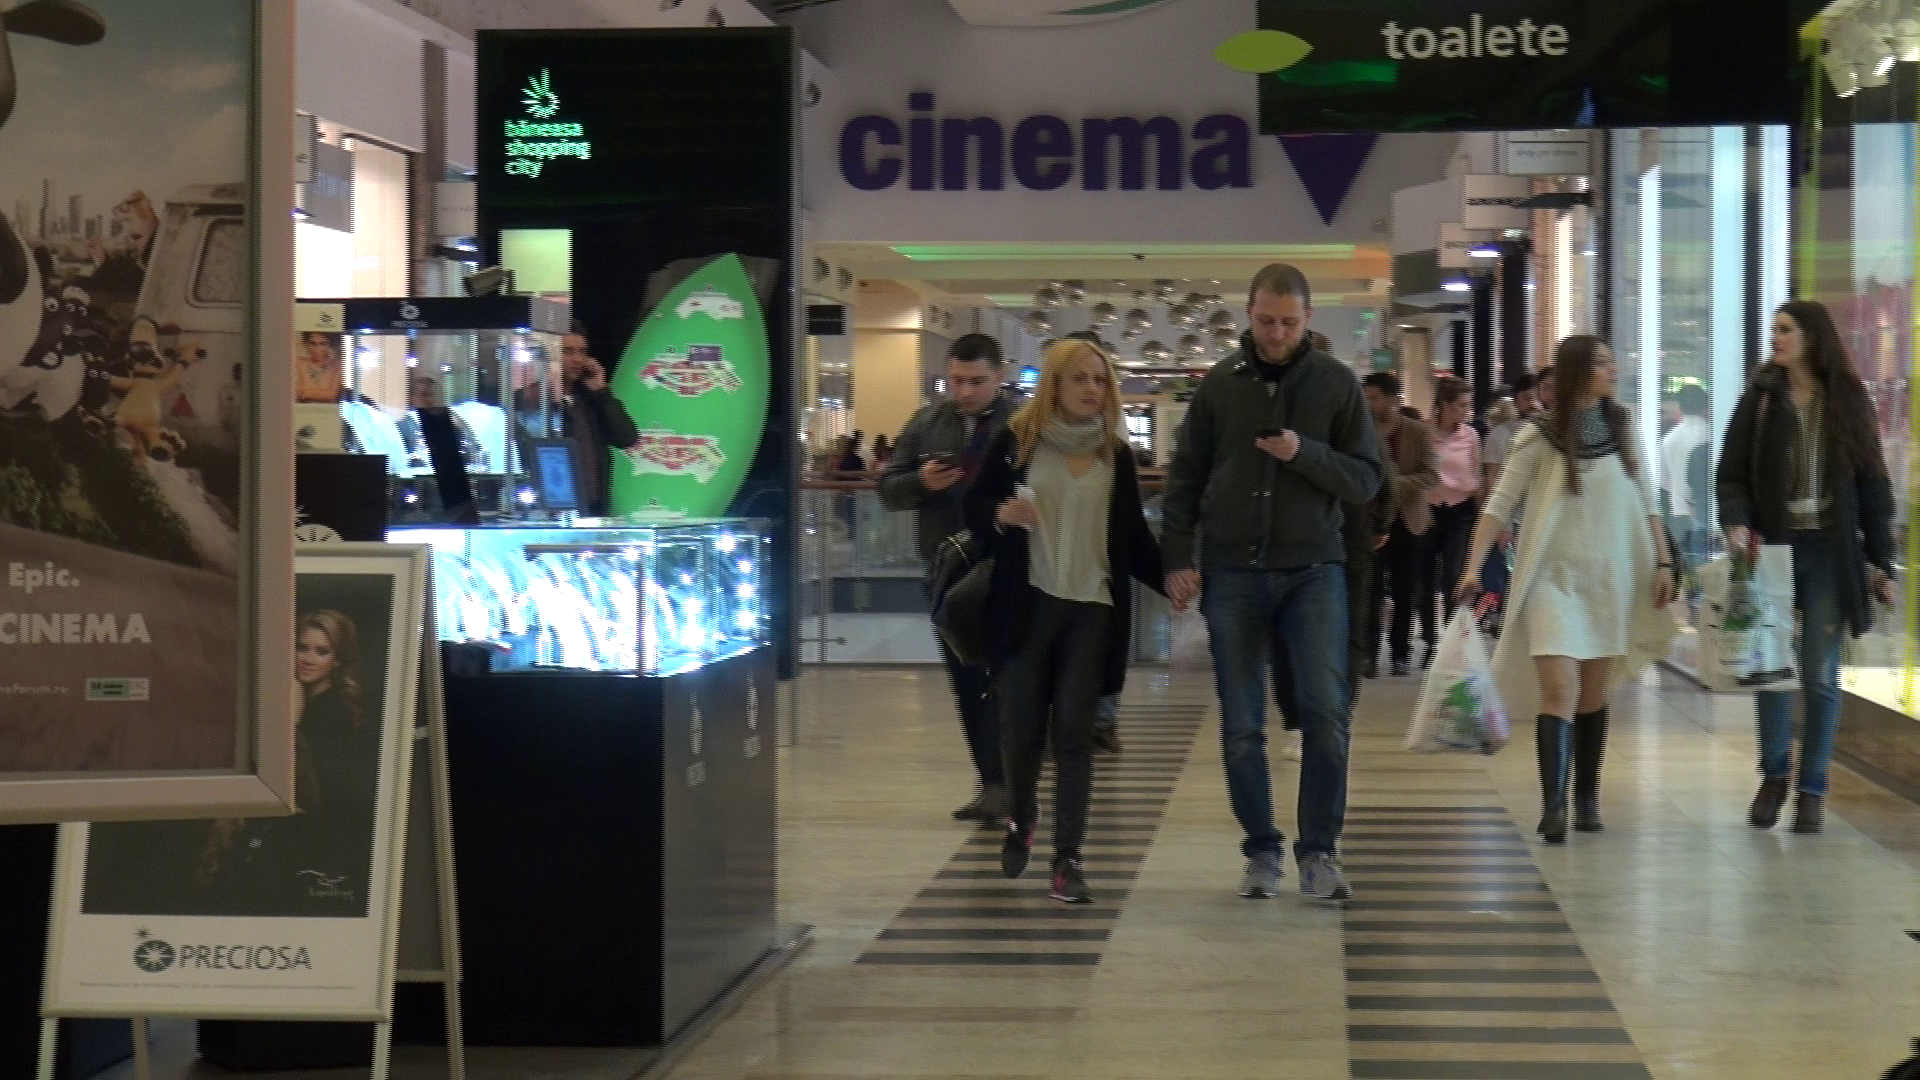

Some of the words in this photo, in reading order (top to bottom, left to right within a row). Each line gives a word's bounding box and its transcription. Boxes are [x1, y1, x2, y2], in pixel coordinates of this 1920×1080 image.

[1379, 12, 1569, 59] toalete
[505, 139, 591, 160] shopping
[839, 93, 1253, 190] cinema
[505, 158, 544, 179] city
[8, 561, 80, 593] Epic.
[0, 613, 152, 642] CINEMA
[179, 945, 312, 970] PRECIOSA
